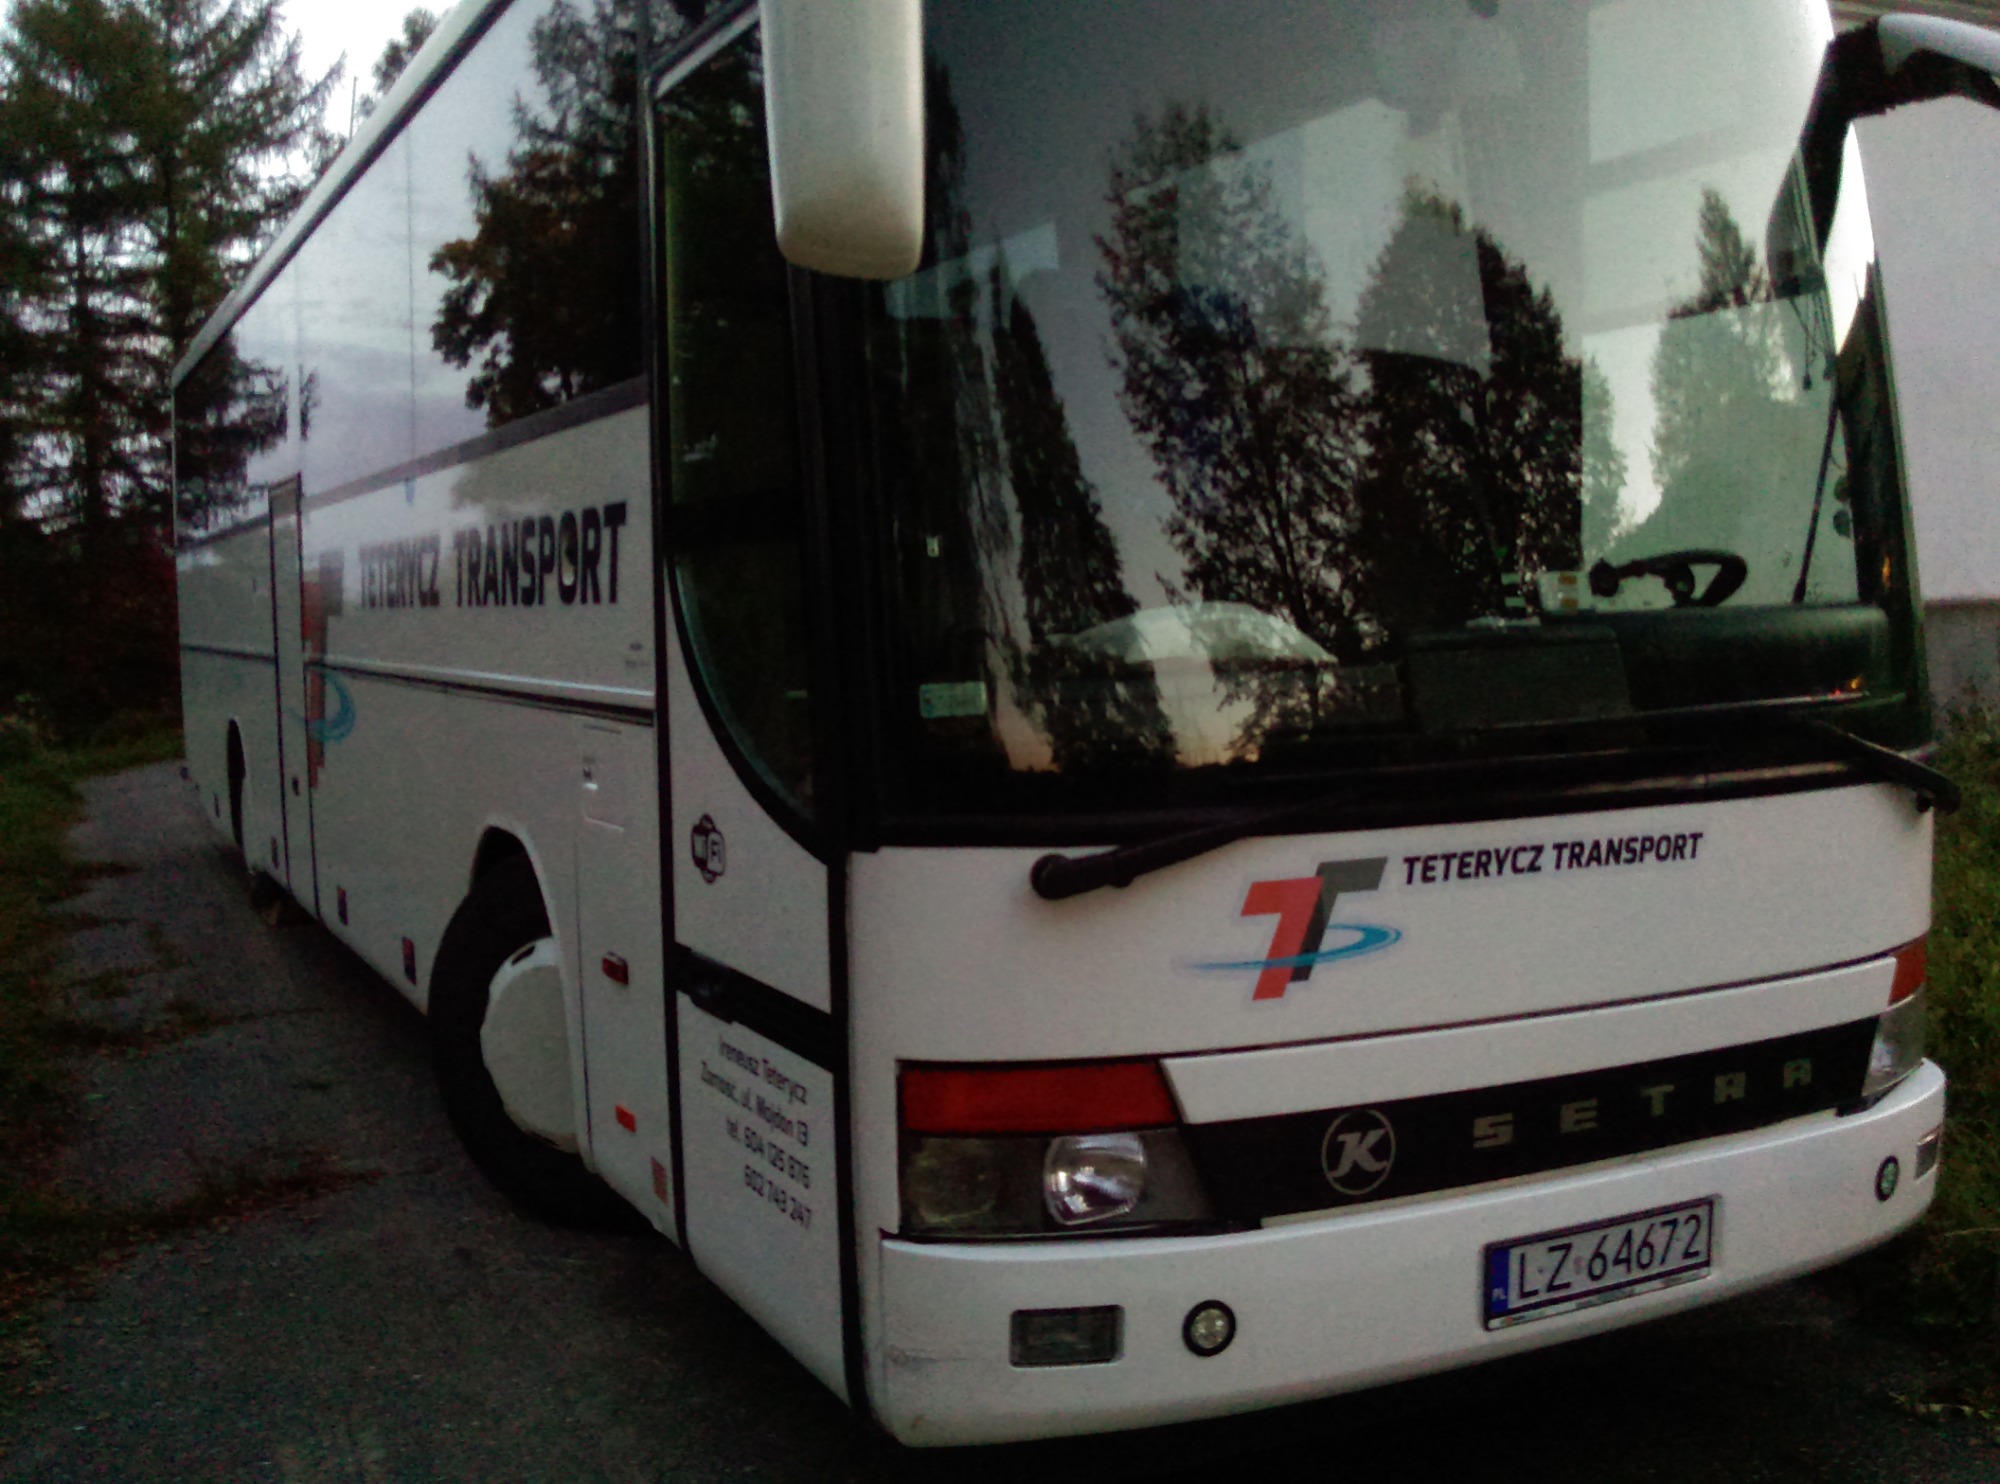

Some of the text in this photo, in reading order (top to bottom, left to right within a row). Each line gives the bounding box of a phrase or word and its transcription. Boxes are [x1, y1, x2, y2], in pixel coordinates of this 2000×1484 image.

[453, 500, 627, 609] TRANSPORT
[1403, 832, 1704, 885] TETERYCZ TRANSPORT
[1472, 1056, 1814, 1149] SETRA
[1518, 1242, 1574, 1299] LZ
[1586, 1213, 1701, 1282] 64672
